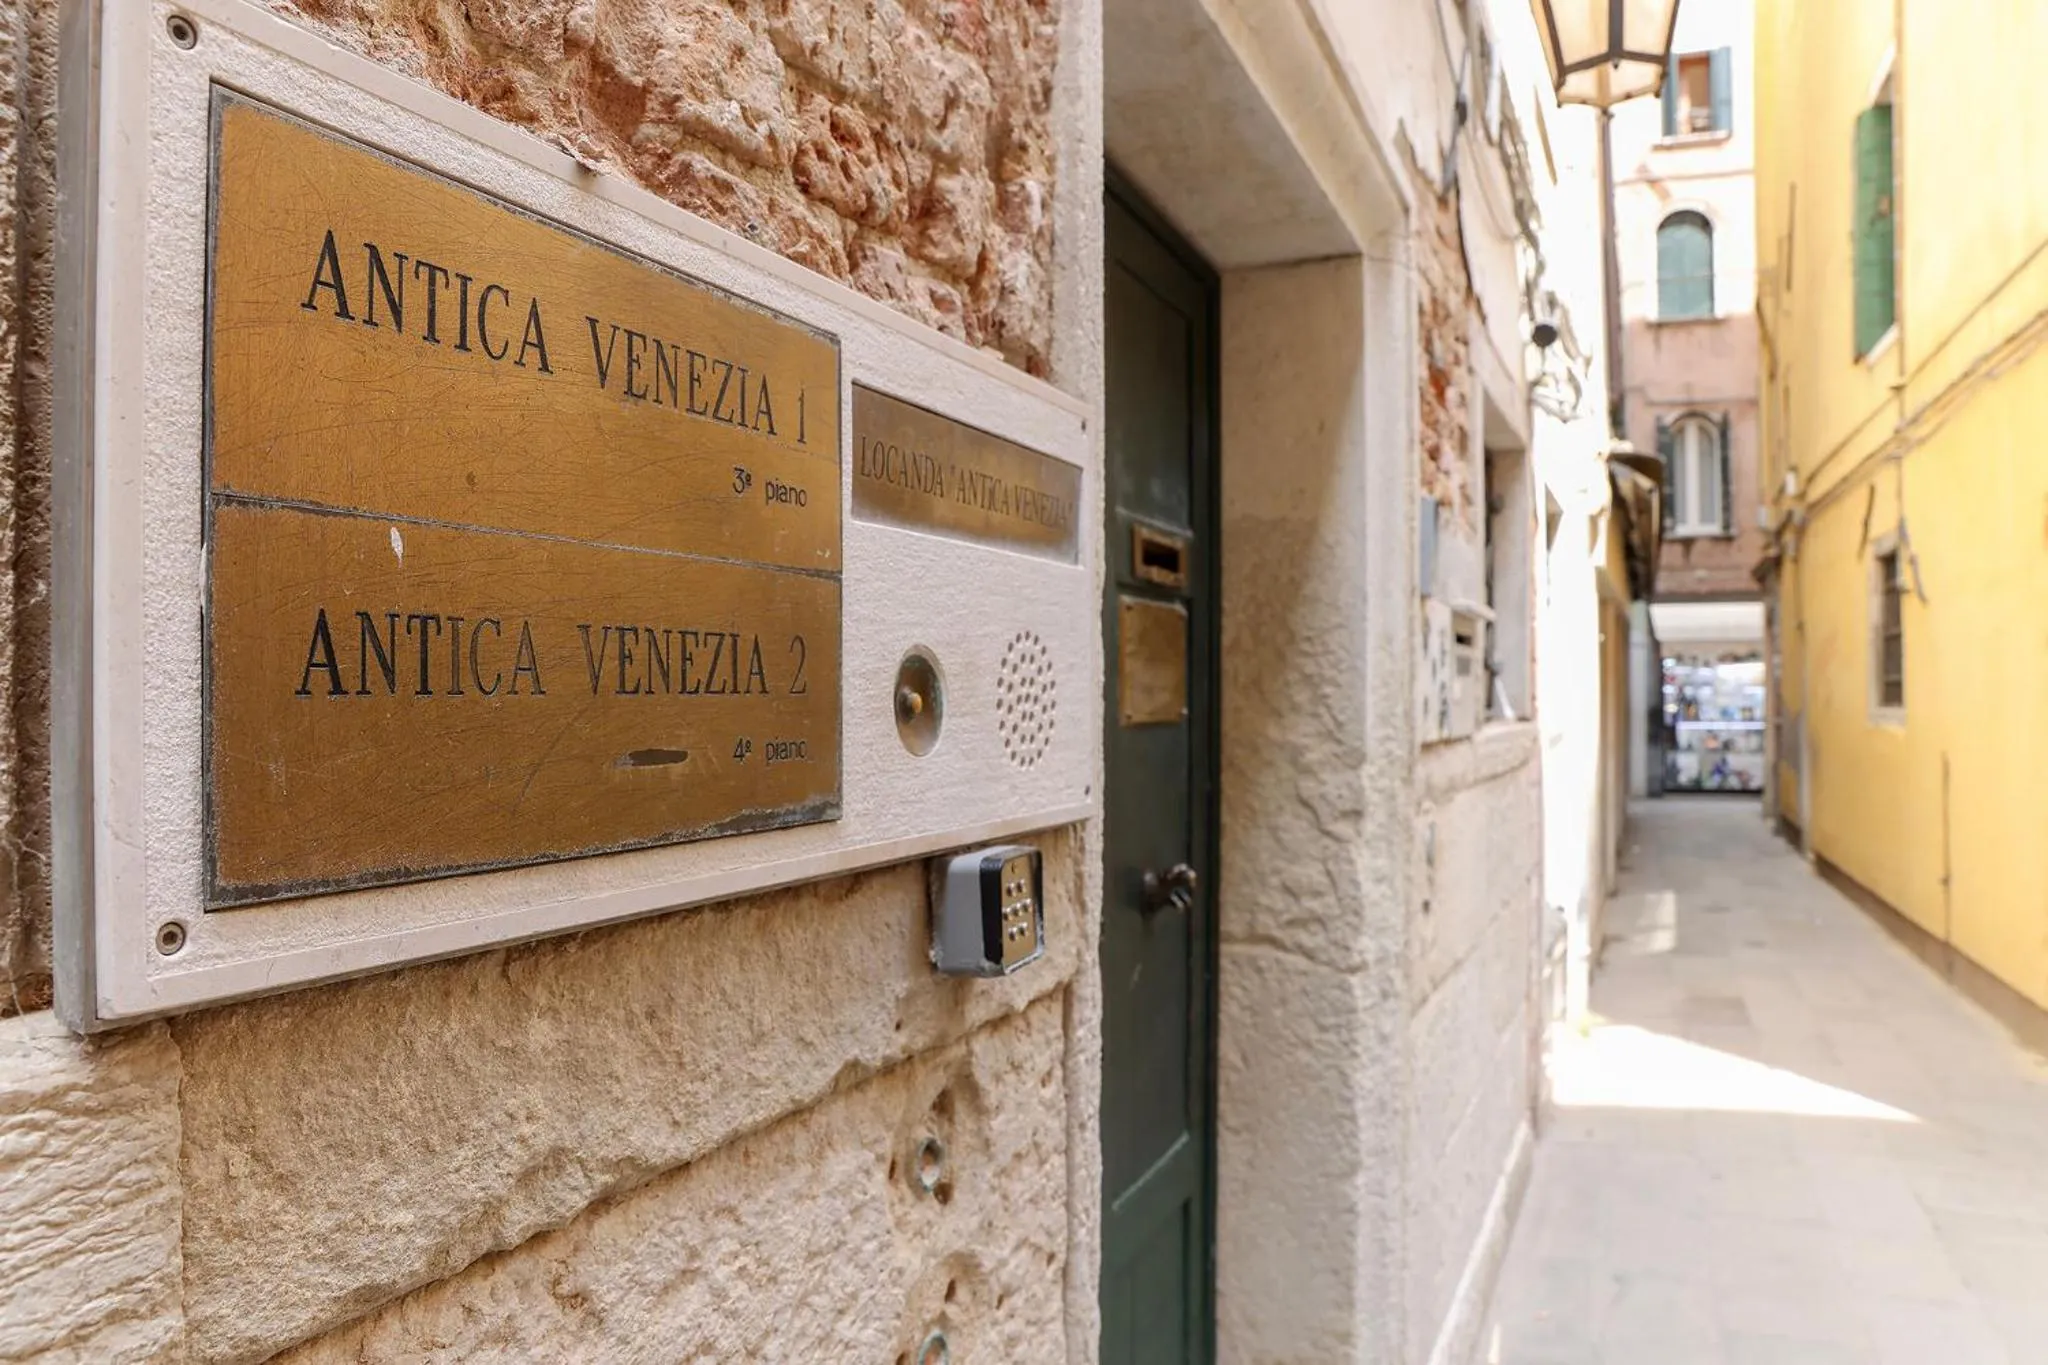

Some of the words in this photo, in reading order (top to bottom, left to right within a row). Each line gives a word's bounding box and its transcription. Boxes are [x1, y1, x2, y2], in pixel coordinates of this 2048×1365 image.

[301, 229, 553, 375] ANTICA
[586, 315, 777, 436] VENEZIA
[797, 388, 806, 445] 1
[765, 477, 807, 507] piano
[860, 436, 944, 499] LOCANDA
[295, 607, 546, 697] ANTICA
[577, 624, 769, 695] VENEZIA
[789, 636, 808, 695] 2
[765, 736, 807, 767] piano
